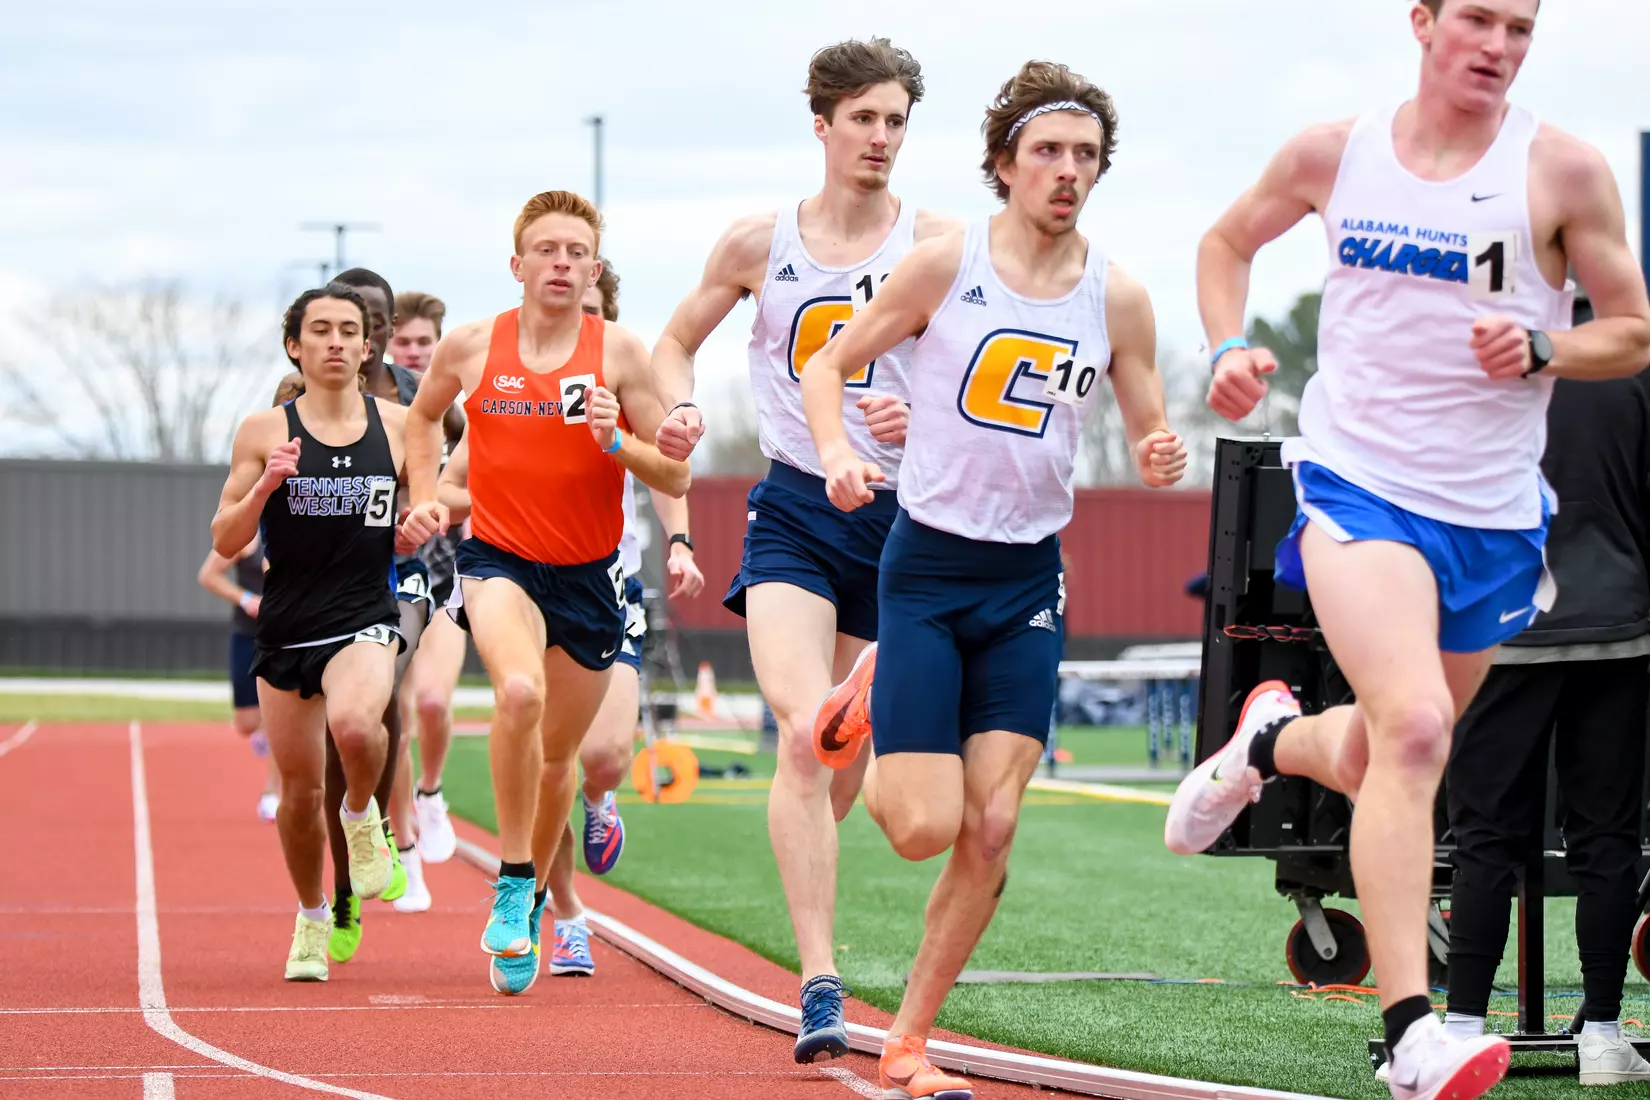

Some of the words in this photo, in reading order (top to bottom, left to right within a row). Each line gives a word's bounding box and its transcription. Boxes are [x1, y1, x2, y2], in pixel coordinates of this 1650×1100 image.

[1341, 218, 1409, 237] ALABAMA
[1416, 227, 1468, 247] HUNTS
[775, 274, 799, 282] adidas
[1475, 241, 1504, 292] 1
[856, 273, 890, 304] 1
[960, 294, 987, 307] adidas
[497, 375, 525, 389] SAC
[957, 328, 1079, 439] C
[1055, 359, 1096, 398] 10
[564, 383, 588, 418] 2
[286, 496, 369, 516] WESLEY
[368, 489, 390, 520] 5
[1029, 619, 1056, 632] adidas
